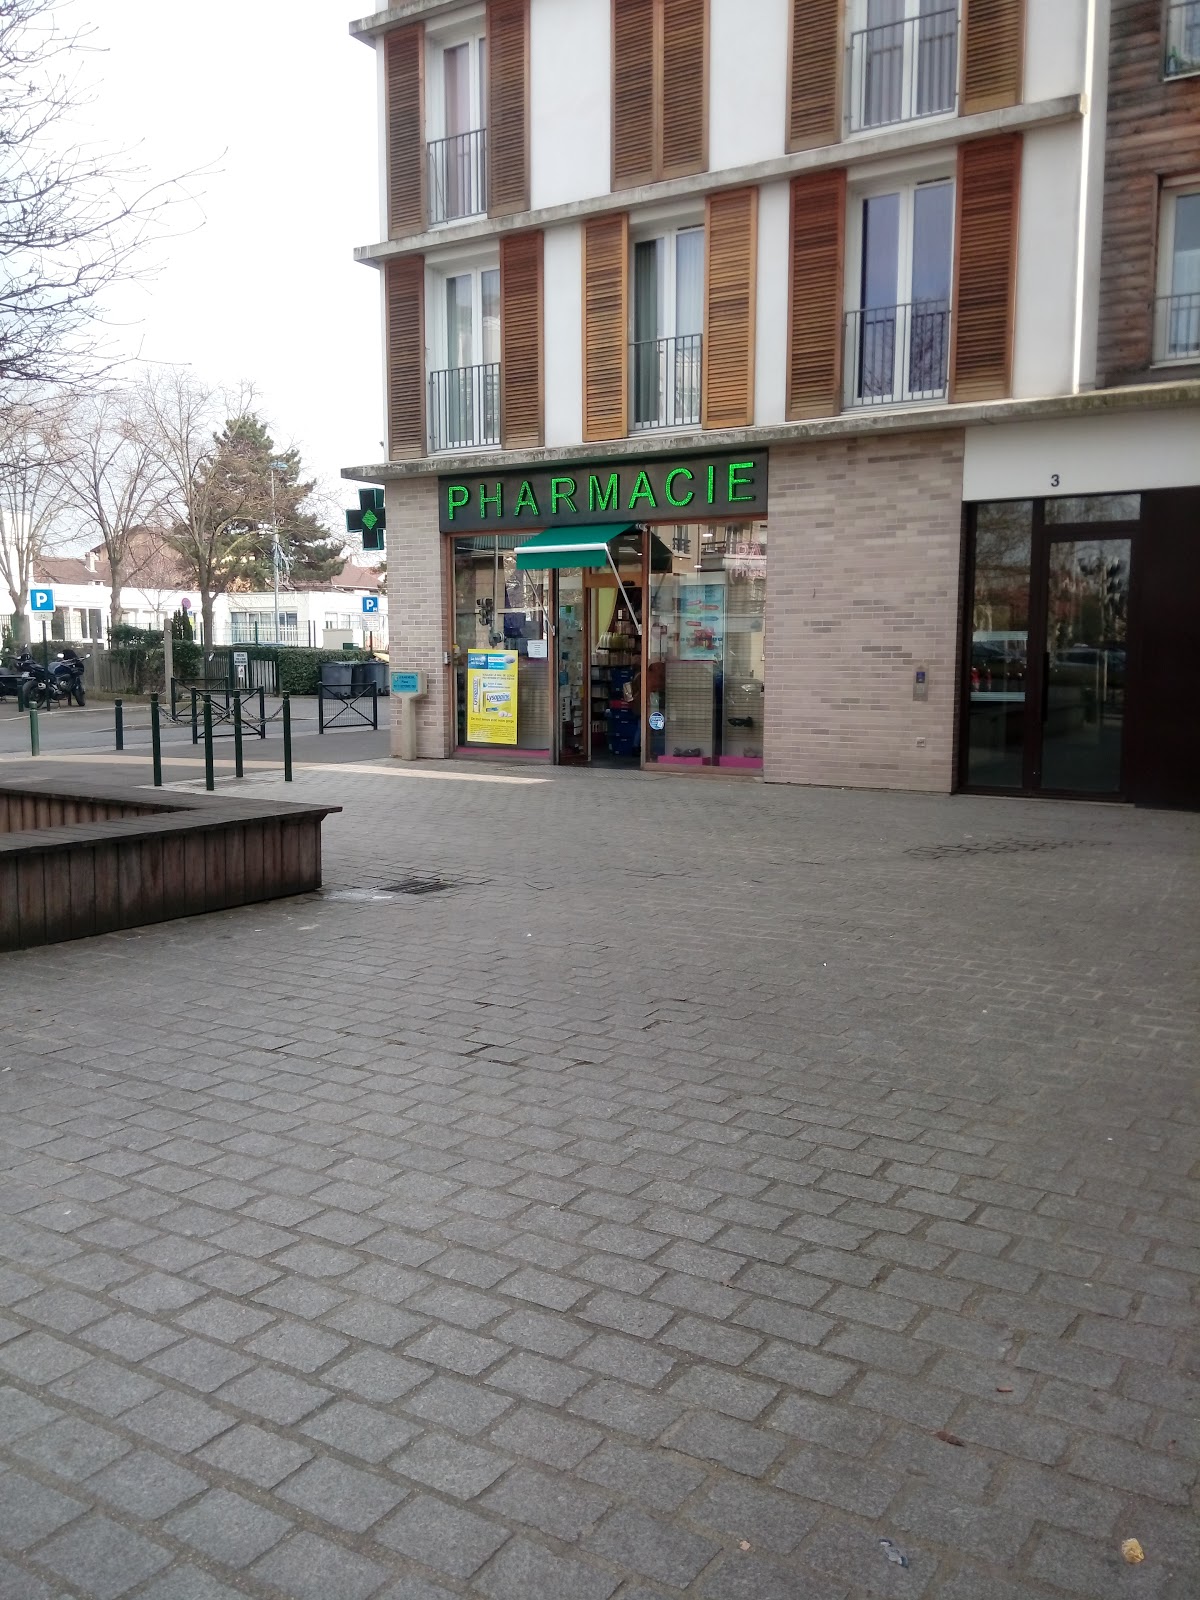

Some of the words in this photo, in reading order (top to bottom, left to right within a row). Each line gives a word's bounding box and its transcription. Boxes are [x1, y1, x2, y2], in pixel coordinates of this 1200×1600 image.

[1050, 473, 1060, 487] 3
[448, 461, 755, 520] PHARMACIE
[36, 592, 48, 608] P
